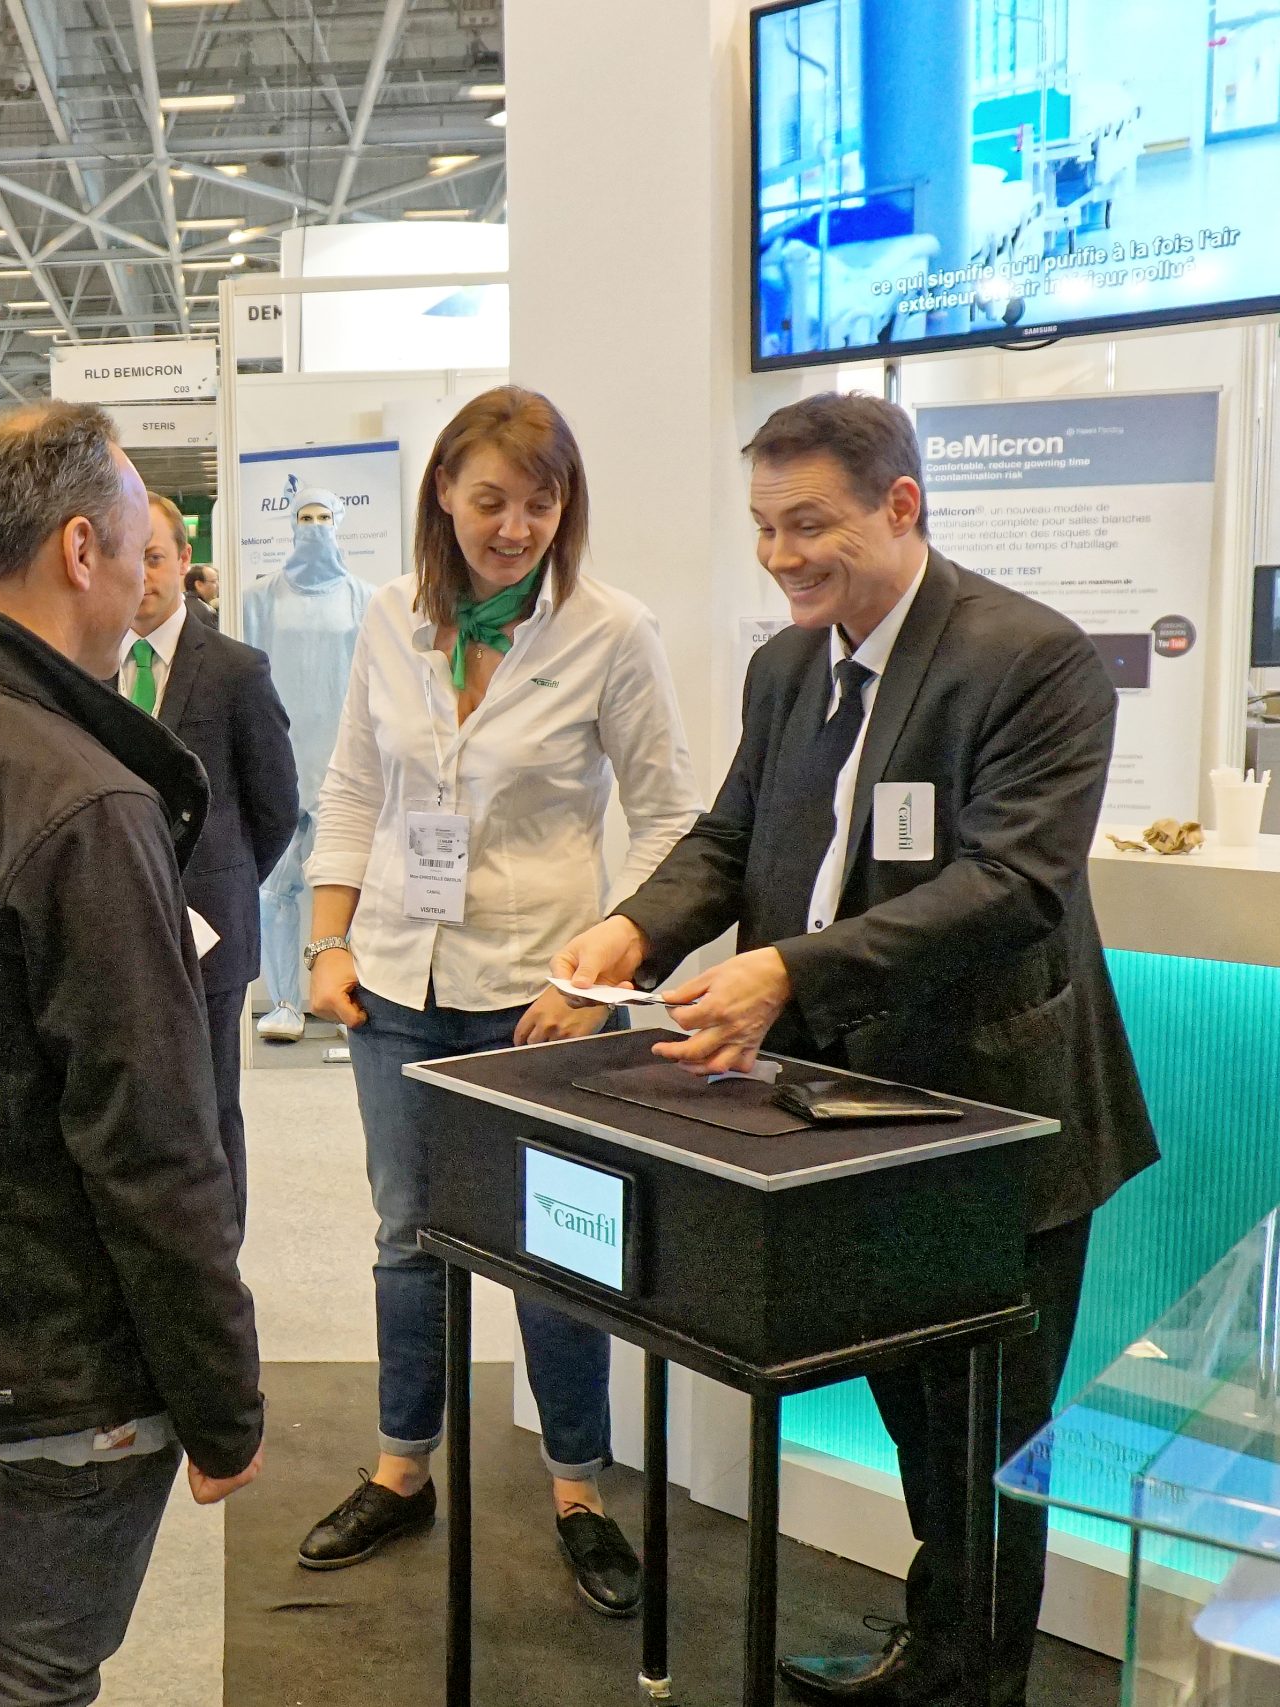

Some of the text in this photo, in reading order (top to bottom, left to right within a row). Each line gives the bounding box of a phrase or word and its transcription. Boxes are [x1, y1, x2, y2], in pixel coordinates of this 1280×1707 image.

[872, 226, 1240, 295] ce qui signifie qu'il purifie à la fois l'air
[898, 289, 977, 314] extérieur
[1024, 325, 1058, 336] SAMSUNG
[84, 364, 183, 380] RLD BEMICRON
[174, 386, 190, 394] C03
[142, 422, 176, 431] STERIS
[927, 433, 1064, 460] BeMicron
[926, 457, 1091, 472] Comfortable, reduce gowning time
[935, 471, 1003, 482] contamination
[1005, 471, 1023, 479] risk
[260, 498, 289, 512] RLD
[1006, 506, 1051, 515] nouveau
[1096, 503, 1110, 512] de
[1042, 518, 1065, 527] pour
[1069, 515, 1098, 525] salles
[1102, 513, 1151, 524] blanches
[1030, 529, 1050, 538] des
[1053, 528, 1091, 540] risques
[1094, 527, 1109, 537] de
[1009, 541, 1022, 551] du
[1026, 541, 1059, 551] temps
[1000, 567, 1014, 576] DE
[1017, 566, 1042, 576] TEST
[899, 806, 913, 850] camfil
[420, 906, 445, 914] VISITEUR
[554, 1209, 616, 1247] camfil
